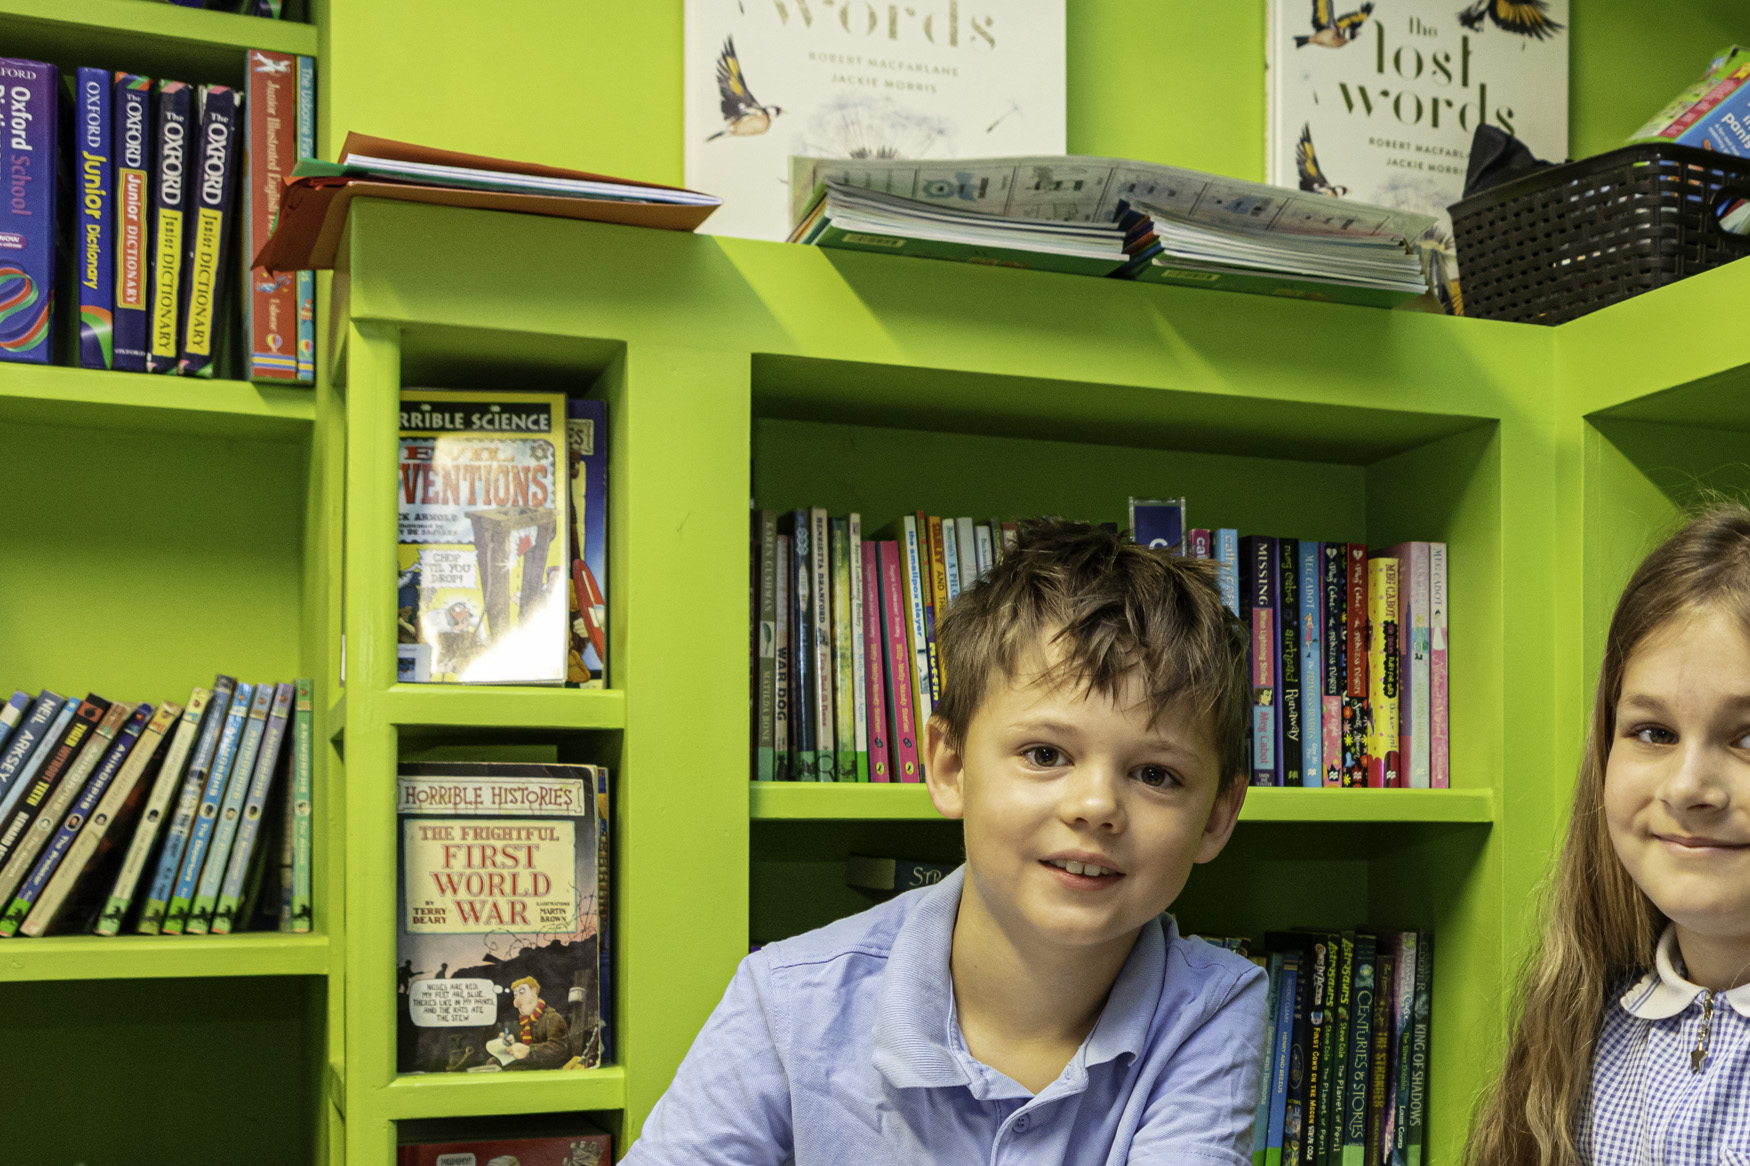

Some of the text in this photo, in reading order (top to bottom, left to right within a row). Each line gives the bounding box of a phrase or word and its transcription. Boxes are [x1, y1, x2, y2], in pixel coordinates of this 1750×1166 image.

[808, 50, 959, 77] ROBERT MACFARLANE
[832, 72, 878, 88] JACKIE
[1374, 19, 1472, 88] lost
[11, 86, 33, 151] Oxford
[125, 102, 143, 168] OXFORD
[166, 111, 184, 122] The
[210, 111, 229, 123] The
[1338, 83, 1515, 137] words
[161, 121, 184, 205] OXFORD
[202, 122, 228, 205] OXFORD
[1369, 137, 1411, 150] ROBERT
[1386, 158, 1424, 170] JACKIE
[11, 155, 33, 216] School
[82, 81, 106, 290] OXFORD Junior Dictionary
[126, 174, 142, 304] Junior DICTIONARY
[158, 214, 179, 352] Junior DICTIONARY
[193, 214, 218, 350] Junior DICTIONARY
[471, 408, 550, 430] SCIENCE
[907, 530, 923, 637] the smallpox slayer
[935, 569, 944, 591] AND
[1257, 542, 1269, 605] MISSING
[1305, 553, 1315, 609] MEG CABOT
[1386, 563, 1396, 618] MEG CABOT
[1435, 549, 1443, 606] MEG CABOT
[761, 522, 773, 746] KAREN CUSHMAN MATILDA BONE
[1284, 629, 1298, 682] airhead
[776, 646, 786, 721] WAR DOG
[0, 695, 56, 783] NEIL ARKSEY
[1258, 712, 1269, 733] Meg
[1259, 735, 1269, 764] Cabot
[0, 720, 87, 847] TIGER WITHOUT TEETH BERNARD
[405, 785, 573, 807] HORRIBLE HISTORIES
[419, 826, 560, 842] THE FRIGHTFUL
[441, 843, 540, 870] FIRST
[412, 907, 447, 915] TERRY
[429, 871, 552, 897] WORLD
[453, 899, 531, 925] WAR
[412, 916, 447, 924] DEARY
[1310, 1028, 1320, 1097] FIRST THE
[1350, 990, 1373, 1138] CENTURIES STORIES
[1409, 1024, 1426, 1127] KING OF SHADOWS
[1333, 1080, 1345, 1152] Planet Peril
